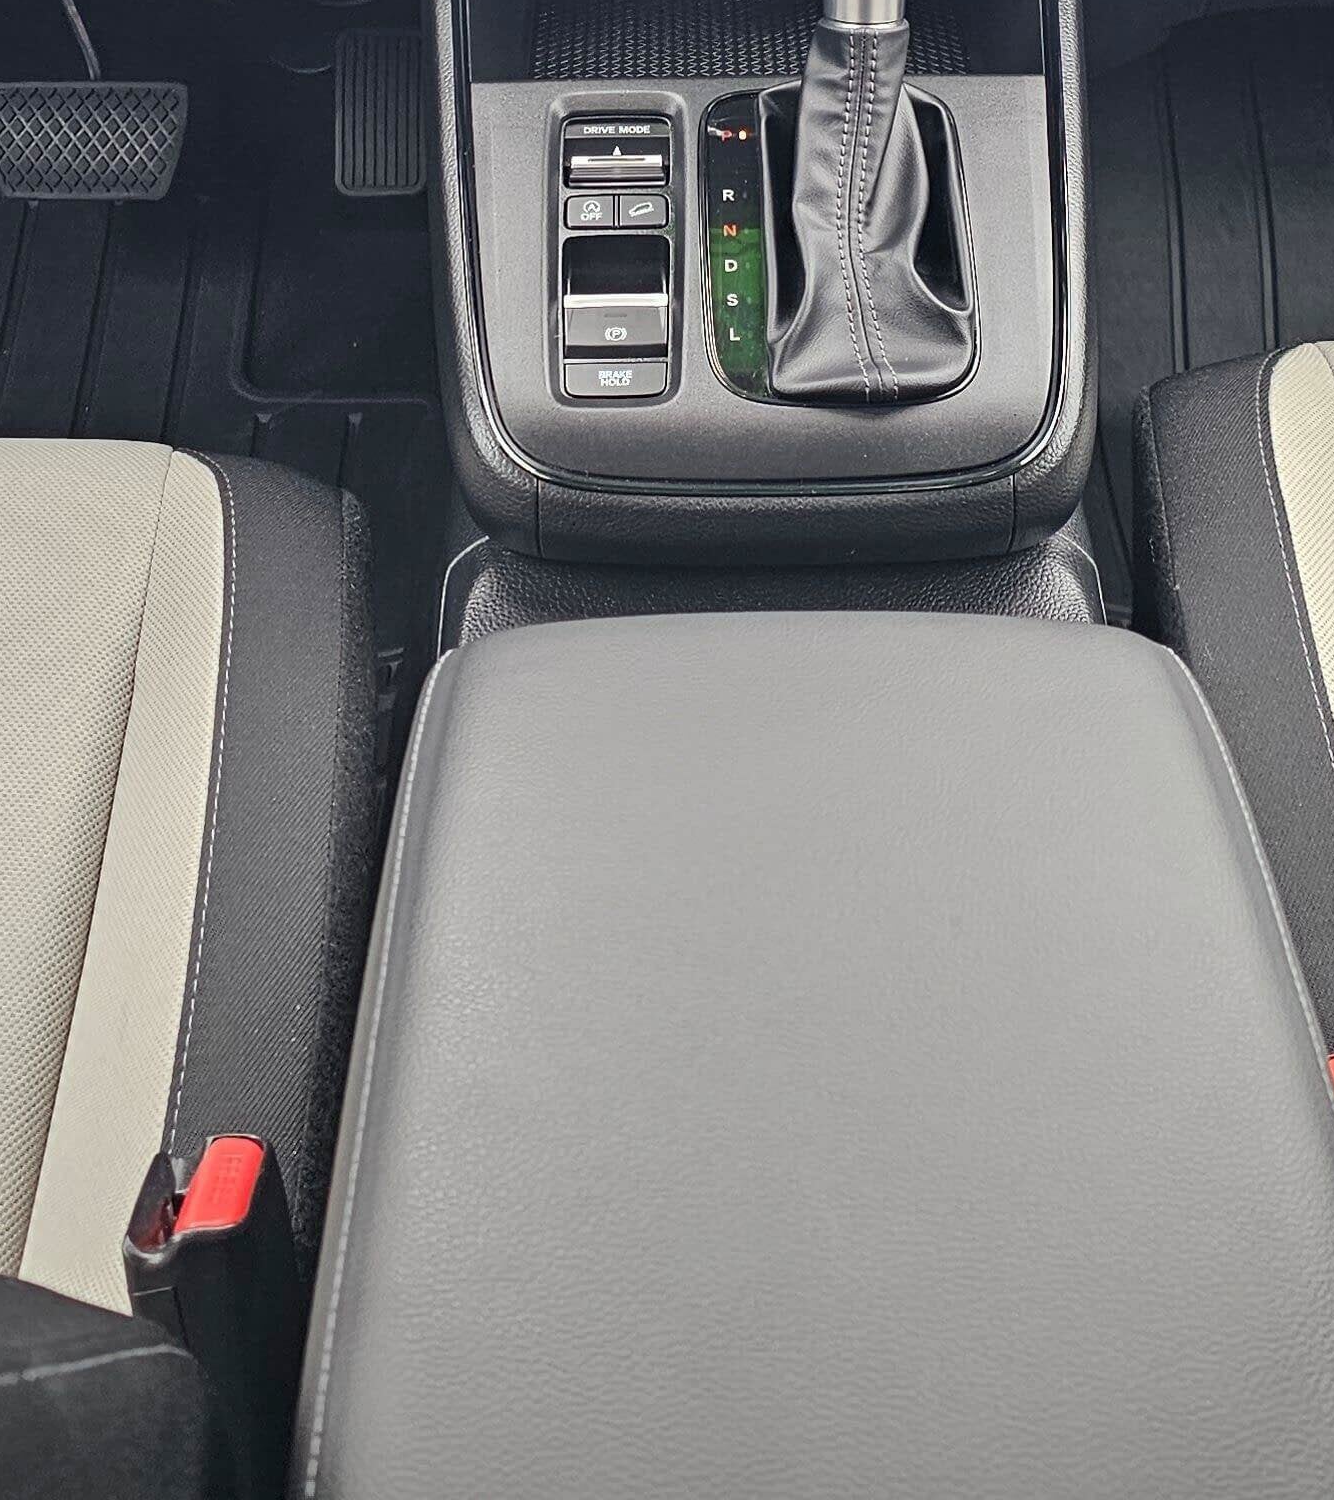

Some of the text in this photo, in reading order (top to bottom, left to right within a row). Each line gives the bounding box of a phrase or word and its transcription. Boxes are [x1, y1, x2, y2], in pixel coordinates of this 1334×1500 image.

[583, 125, 651, 135] DRIVE MODE
[722, 188, 736, 201] R
[580, 212, 604, 221] OFF
[723, 224, 737, 237] N
[724, 259, 738, 273] D
[726, 293, 739, 307] S
[729, 327, 741, 342] L
[598, 370, 633, 380] BRAKE
[600, 378, 631, 387] HOLD
